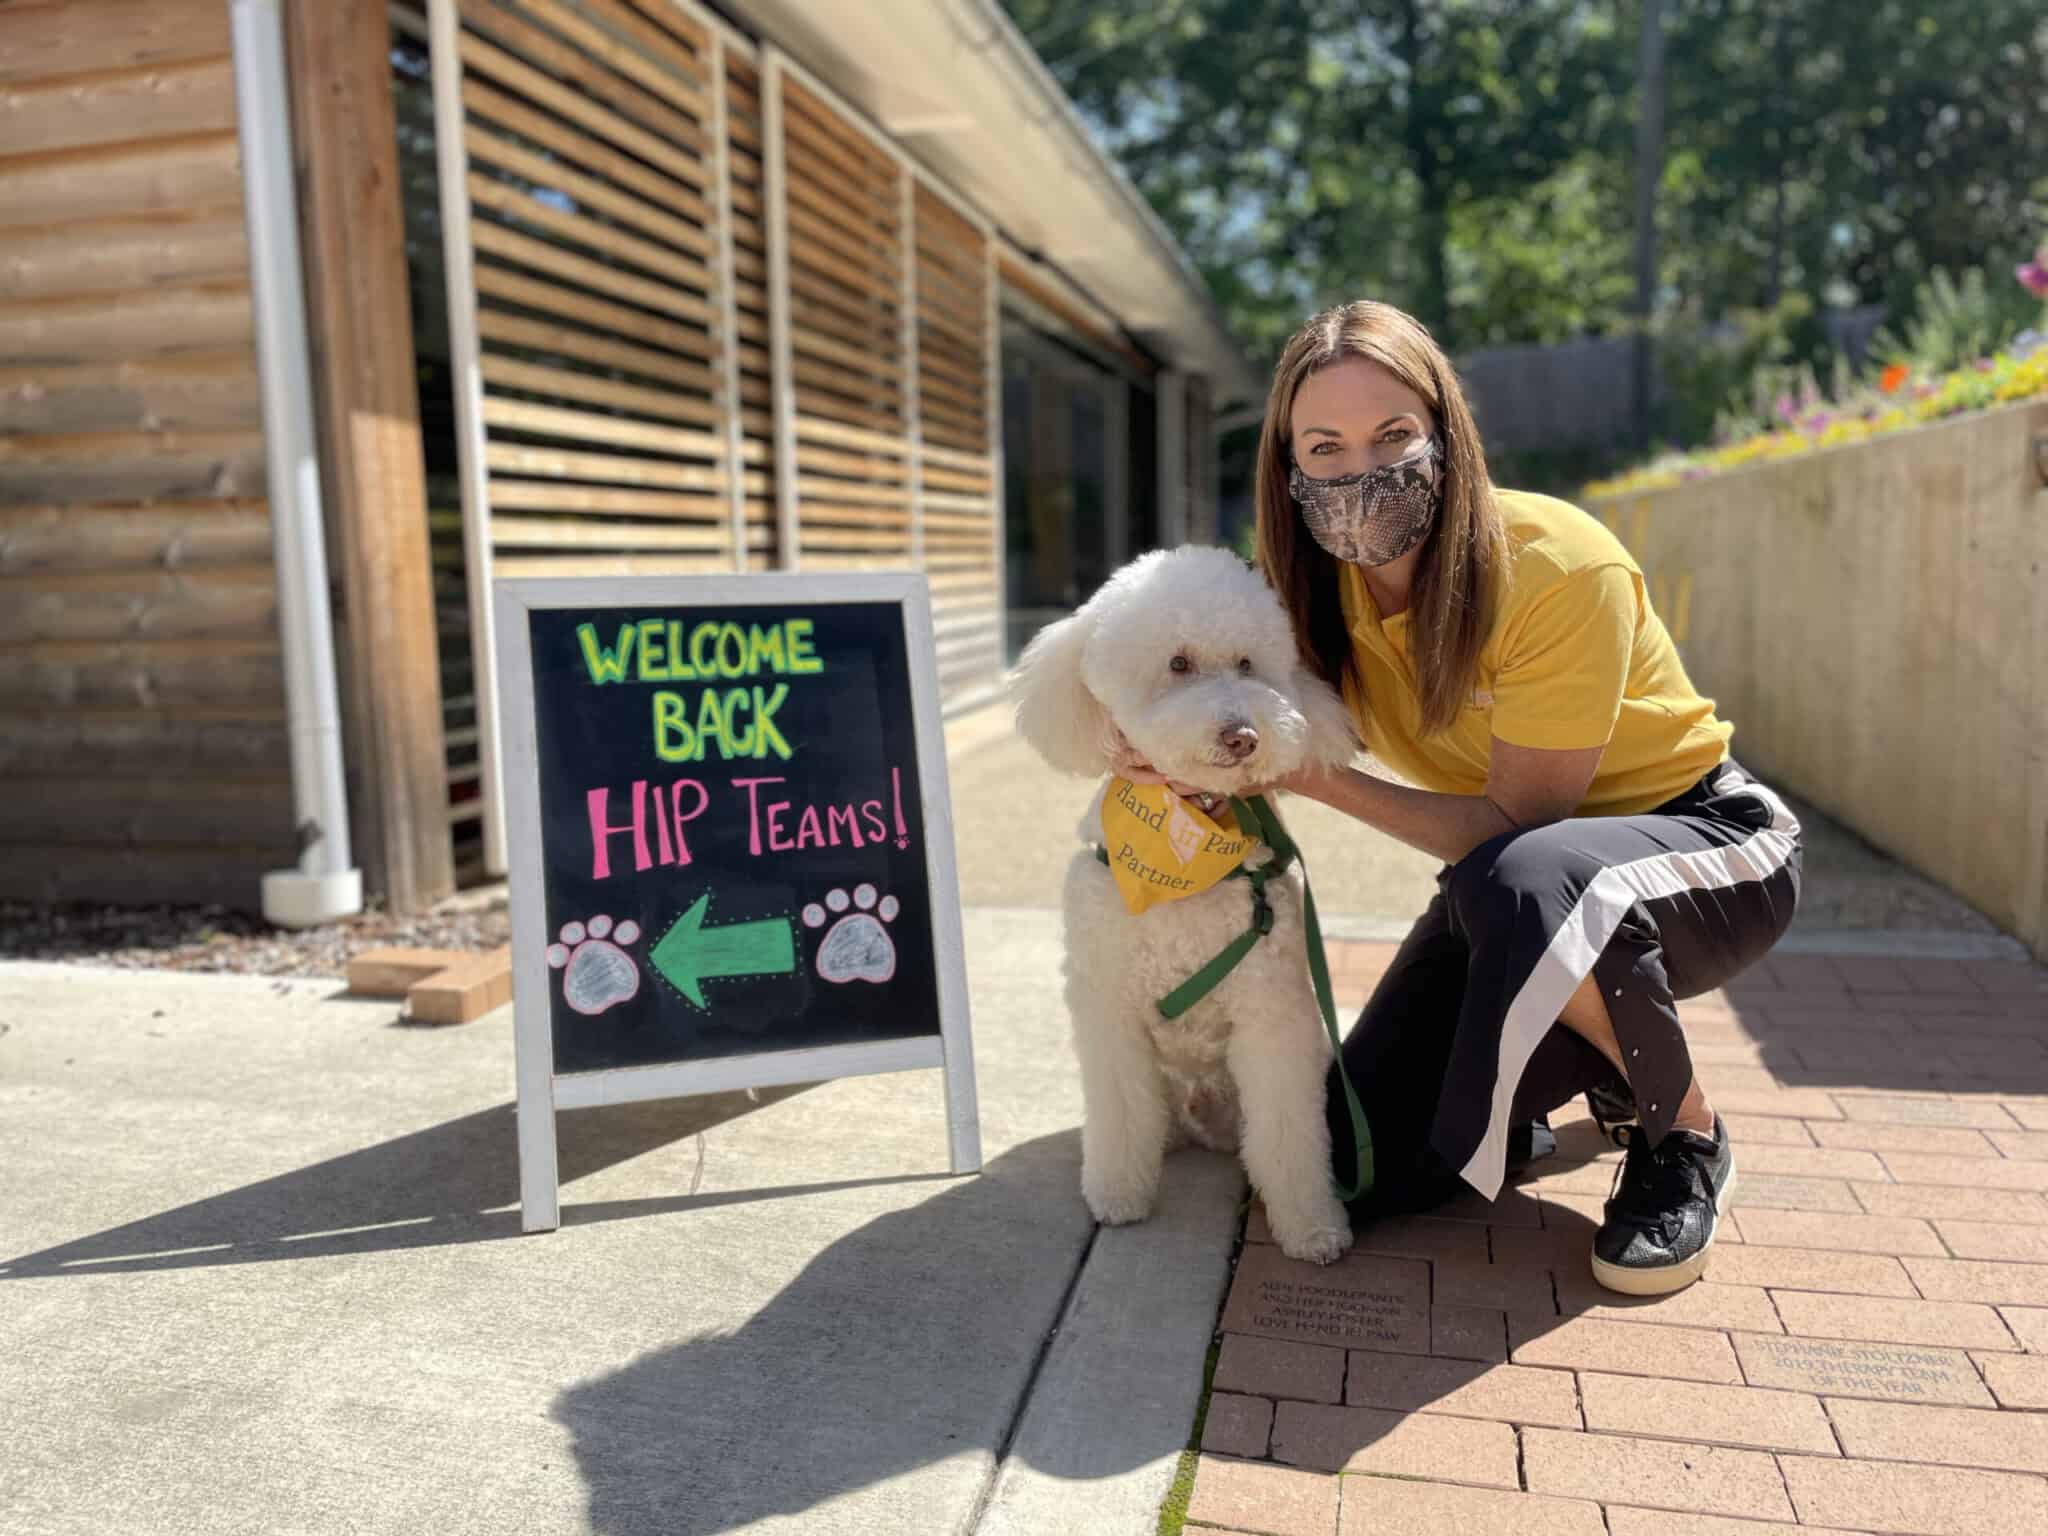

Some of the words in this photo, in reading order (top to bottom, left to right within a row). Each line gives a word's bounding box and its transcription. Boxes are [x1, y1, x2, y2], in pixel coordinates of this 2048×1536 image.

[577, 618, 824, 684] WELCOME
[653, 684, 793, 762] BACK
[587, 778, 710, 880] HIP
[1116, 782, 1168, 833] Hand
[1203, 831, 1246, 856] Paw
[1116, 841, 1195, 891] Partner
[1253, 1313, 1289, 1329] LOVE
[1840, 1376, 1877, 1391] THE
[1878, 1378, 1927, 1395] YEAR
